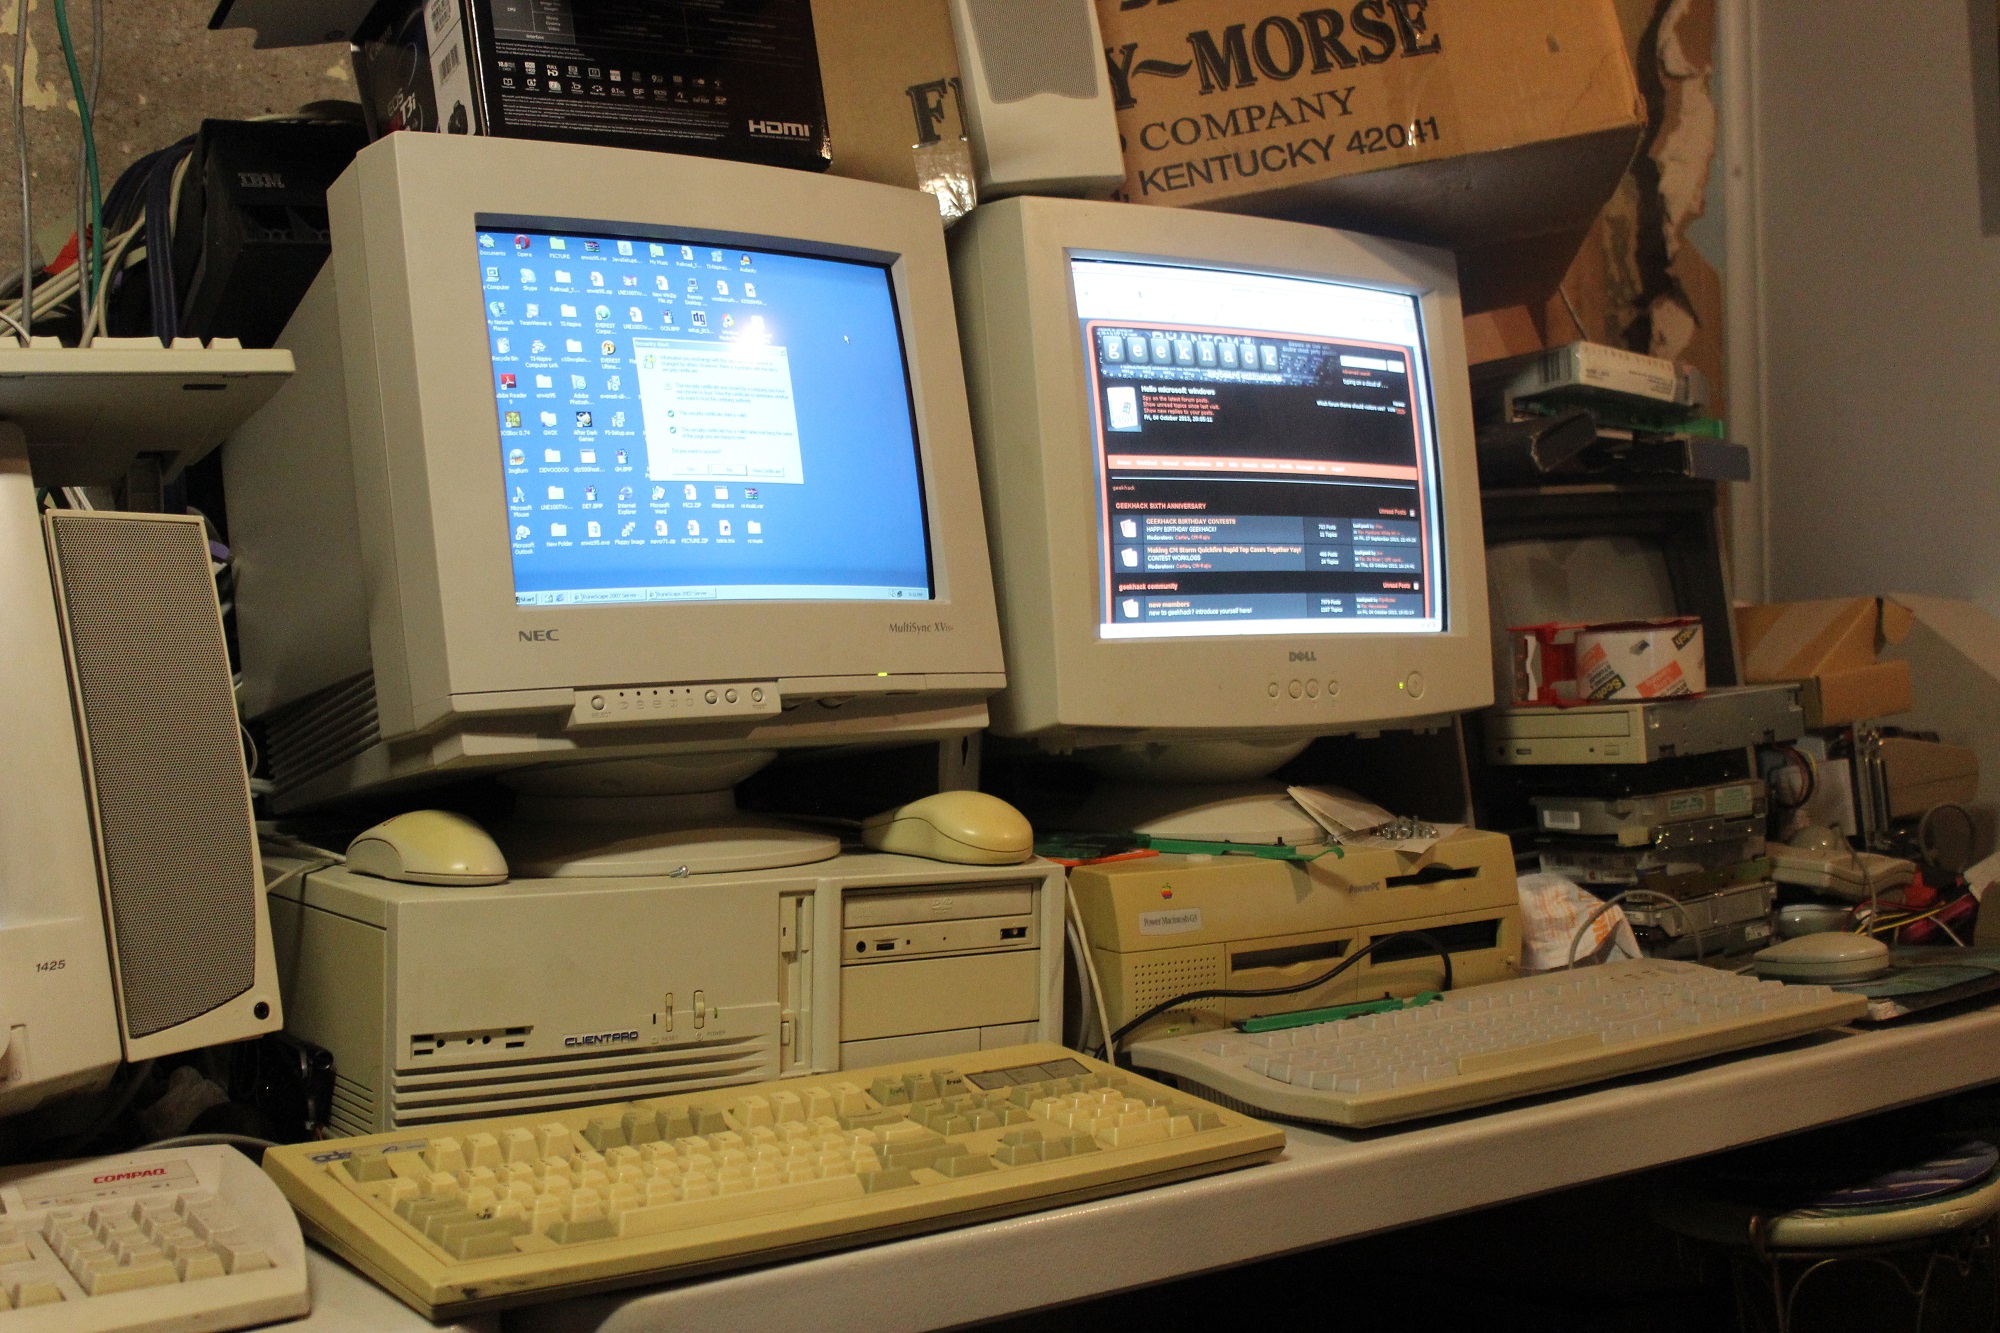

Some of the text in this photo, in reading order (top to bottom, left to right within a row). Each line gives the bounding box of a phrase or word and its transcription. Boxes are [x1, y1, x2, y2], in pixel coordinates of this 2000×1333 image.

[1139, 86, 1356, 151] COMPANY
[748, 119, 810, 137] HDMI
[1138, 134, 1335, 195] KENTUCKY
[238, 172, 285, 189] IBM
[1140, 386, 1215, 396] Hello microsoft windows
[1116, 502, 1148, 510] GEEKHACK
[1149, 502, 1166, 510] SIXTH
[1223, 546, 1238, 554] Rapid
[1239, 546, 1248, 554] Top
[1267, 546, 1289, 554] Together
[1118, 582, 1178, 592] geekhack community
[1168, 608, 1195, 617] geekhack?
[1219, 608, 1238, 616] yourself
[888, 622, 932, 634] MultiSync
[518, 628, 560, 642] NEC
[1289, 651, 1317, 662] DELL
[1143, 918, 1161, 926] Power
[1161, 914, 1188, 925] Macintosh
[35, 959, 66, 973] 1425
[564, 1030, 639, 1048] CLIENTPRO
[92, 1166, 167, 1185] COMPAQ
